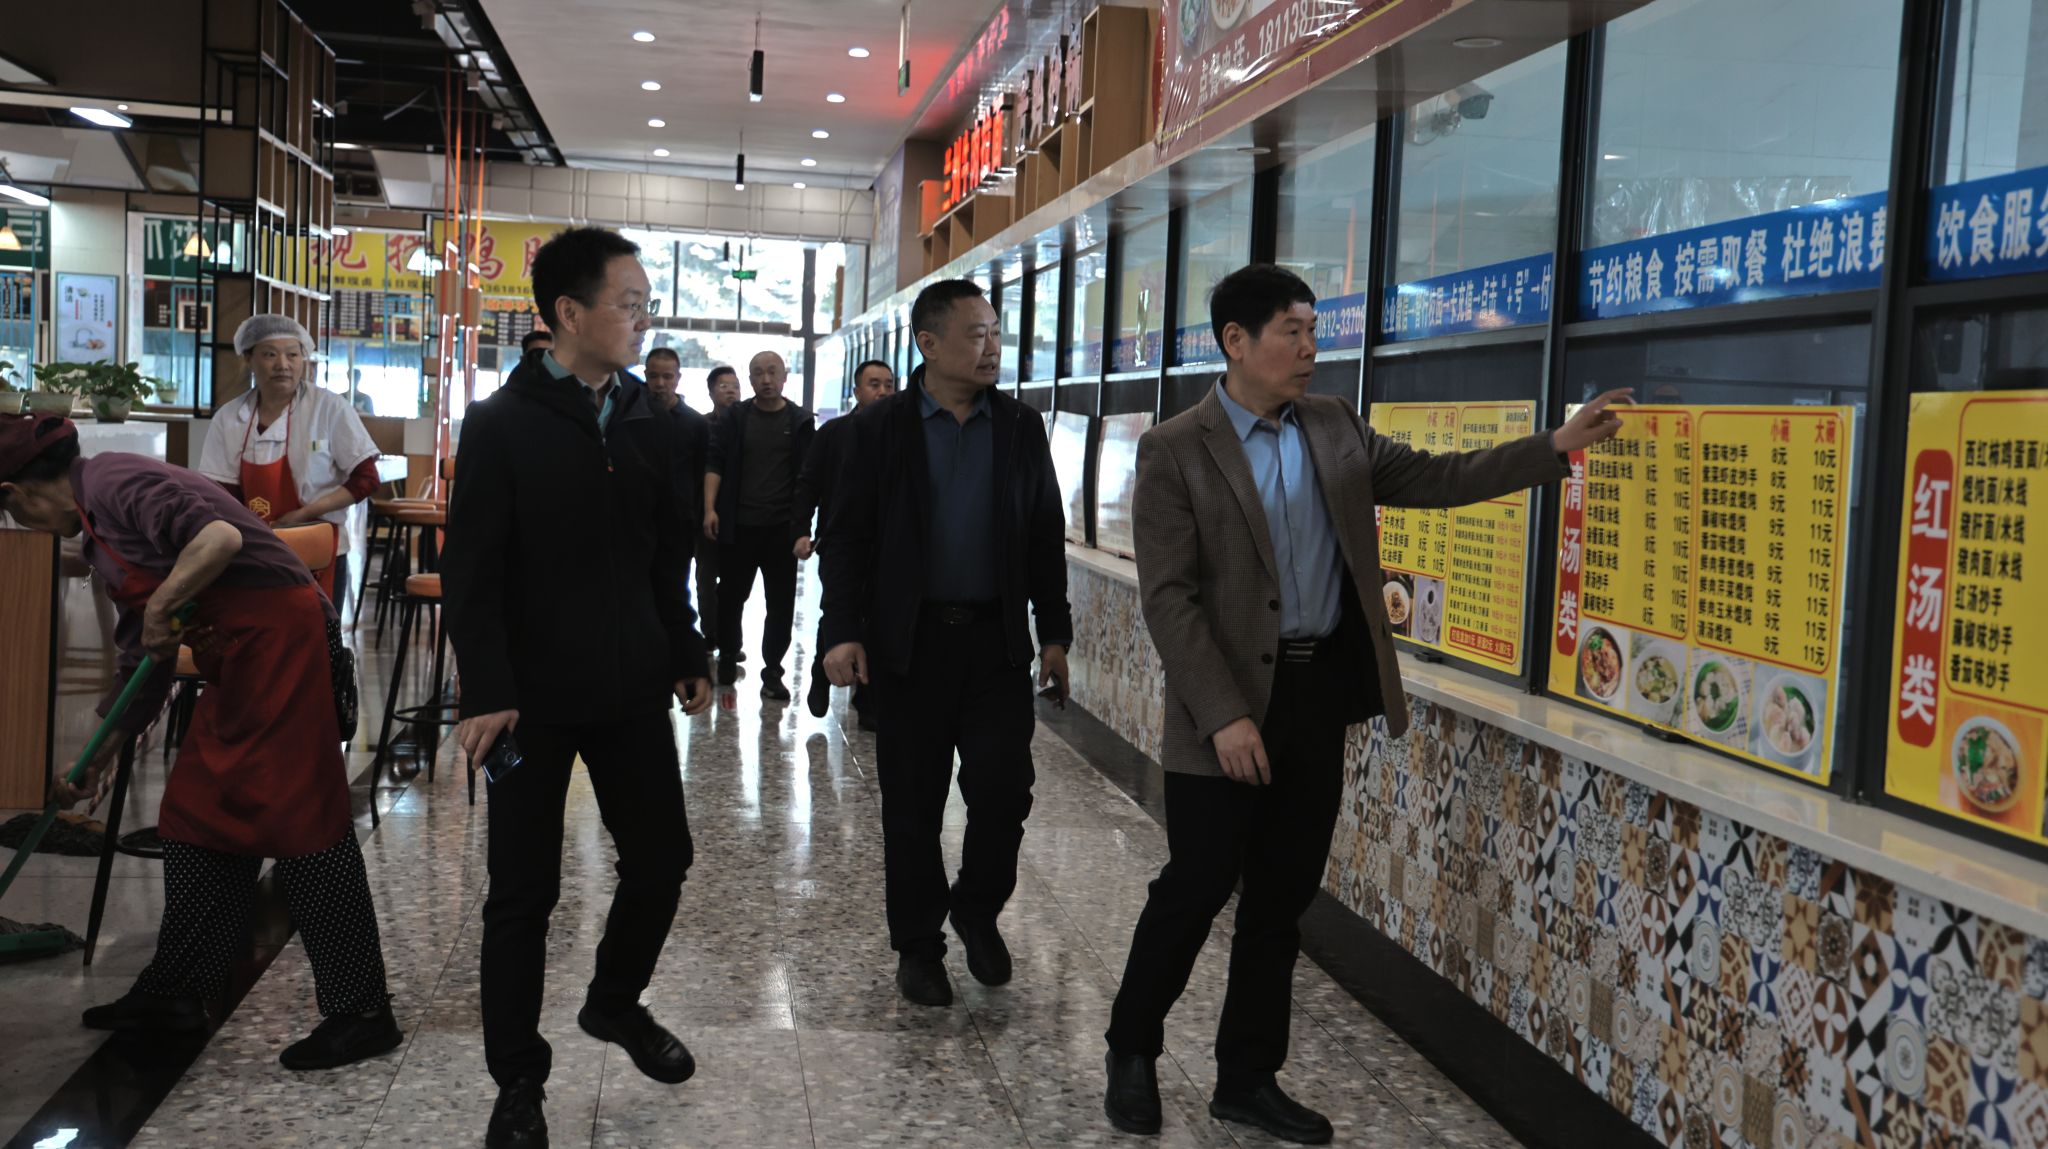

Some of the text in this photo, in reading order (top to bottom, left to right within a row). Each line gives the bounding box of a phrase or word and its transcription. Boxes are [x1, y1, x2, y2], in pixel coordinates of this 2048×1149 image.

[1588, 206, 1888, 309] 节约粮食 按需取餐 杜绝浪费
[1770, 418, 1836, 444] 小碗 大碗
[1771, 447, 1788, 466] 8元
[1813, 449, 1837, 469] 10元
[1770, 471, 1787, 490] 8元
[1812, 474, 1835, 494] 10元
[1769, 494, 1786, 513] 9元
[1811, 498, 1834, 519] 11元
[1769, 518, 1785, 537] 9元
[1810, 523, 1833, 544] 11元
[1558, 461, 1585, 640] 清汤类
[1768, 541, 1784, 561] 9元
[1809, 547, 1832, 568] 11元
[1767, 565, 1783, 585] 9元
[1808, 572, 1830, 593] 11元
[1766, 588, 1782, 609] 9元
[1807, 596, 1829, 618] 11元
[1900, 473, 1950, 727] 红汤类
[1954, 582, 2003, 617] 红汤抄手
[1764, 612, 1780, 632] 9元
[1805, 620, 1827, 642] 11元
[1764, 636, 1780, 656] 9元
[1803, 645, 1825, 667] 11元
[1950, 652, 2010, 693] 番茄味抄手
